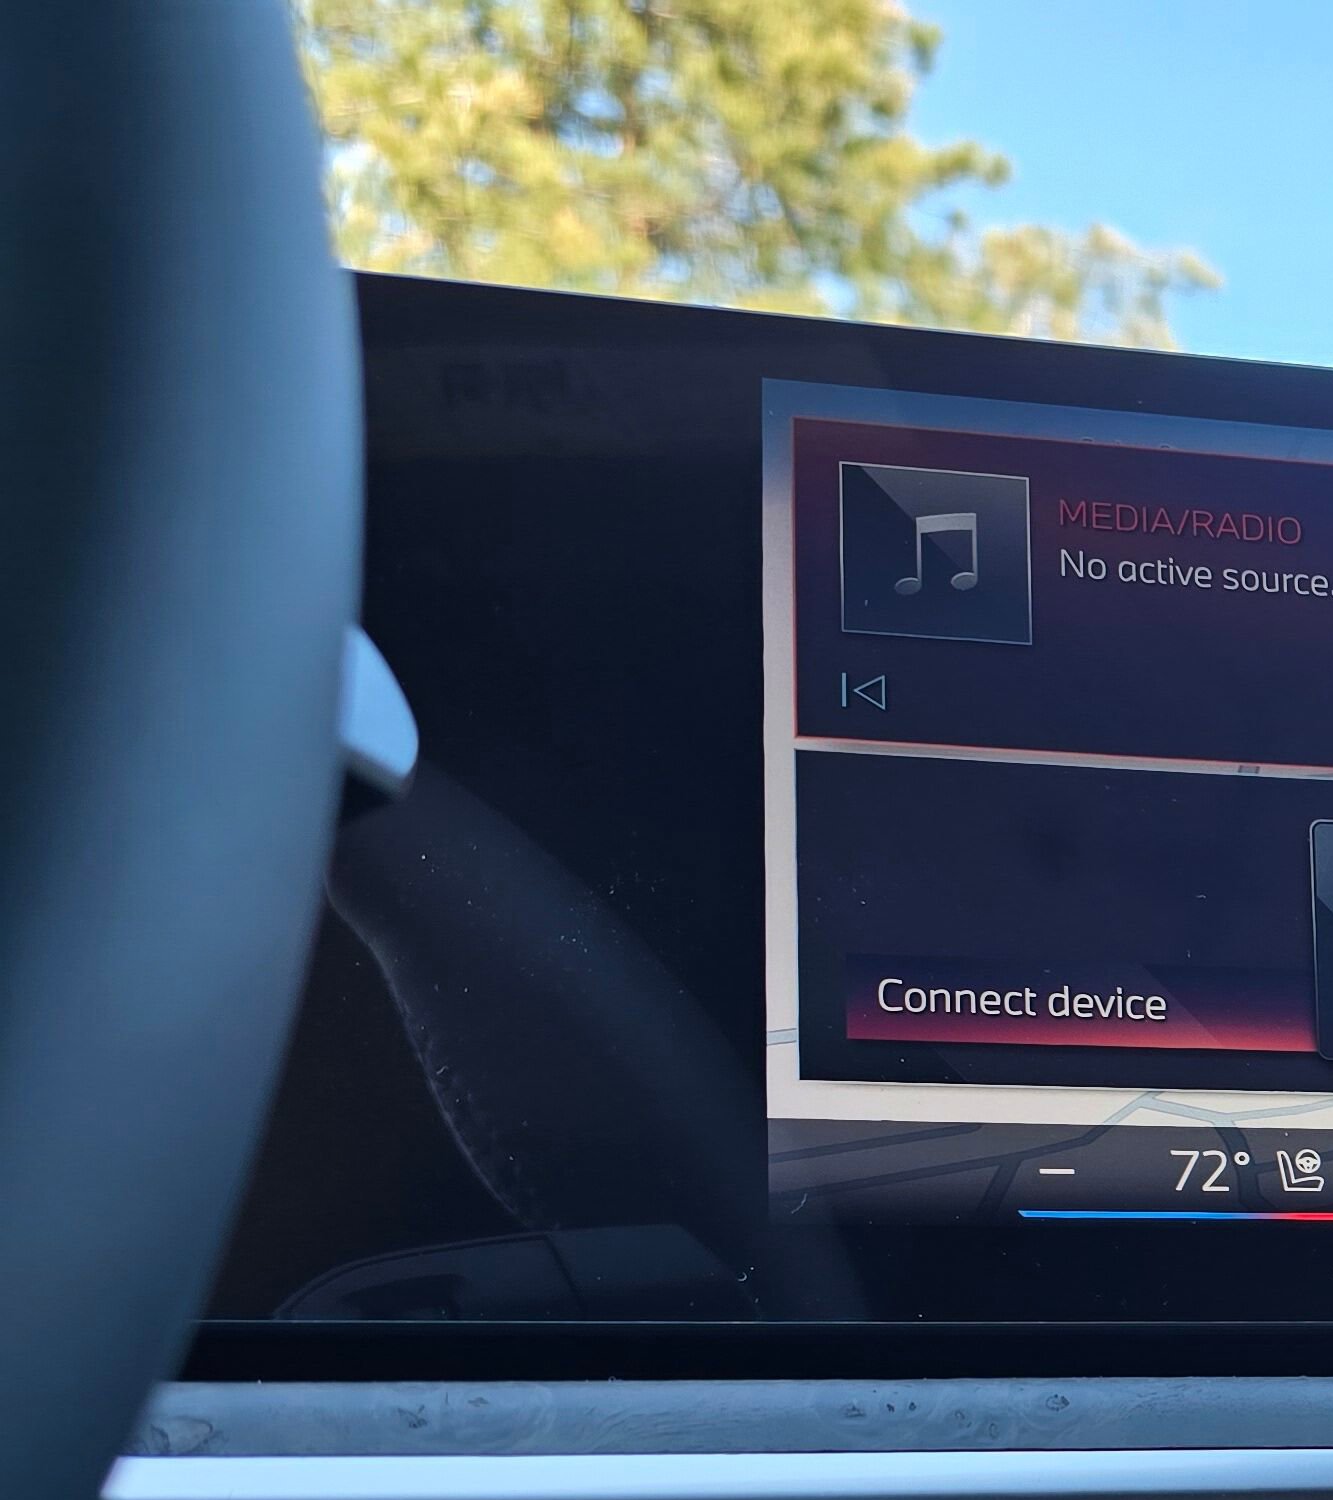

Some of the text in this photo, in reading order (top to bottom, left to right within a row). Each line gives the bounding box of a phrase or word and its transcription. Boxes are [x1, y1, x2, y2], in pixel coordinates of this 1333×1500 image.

[1058, 498, 1302, 545] MEDIA/RADIO
[1060, 548, 1107, 581] No
[1118, 556, 1213, 589] active
[878, 978, 1168, 1020] Connect device
